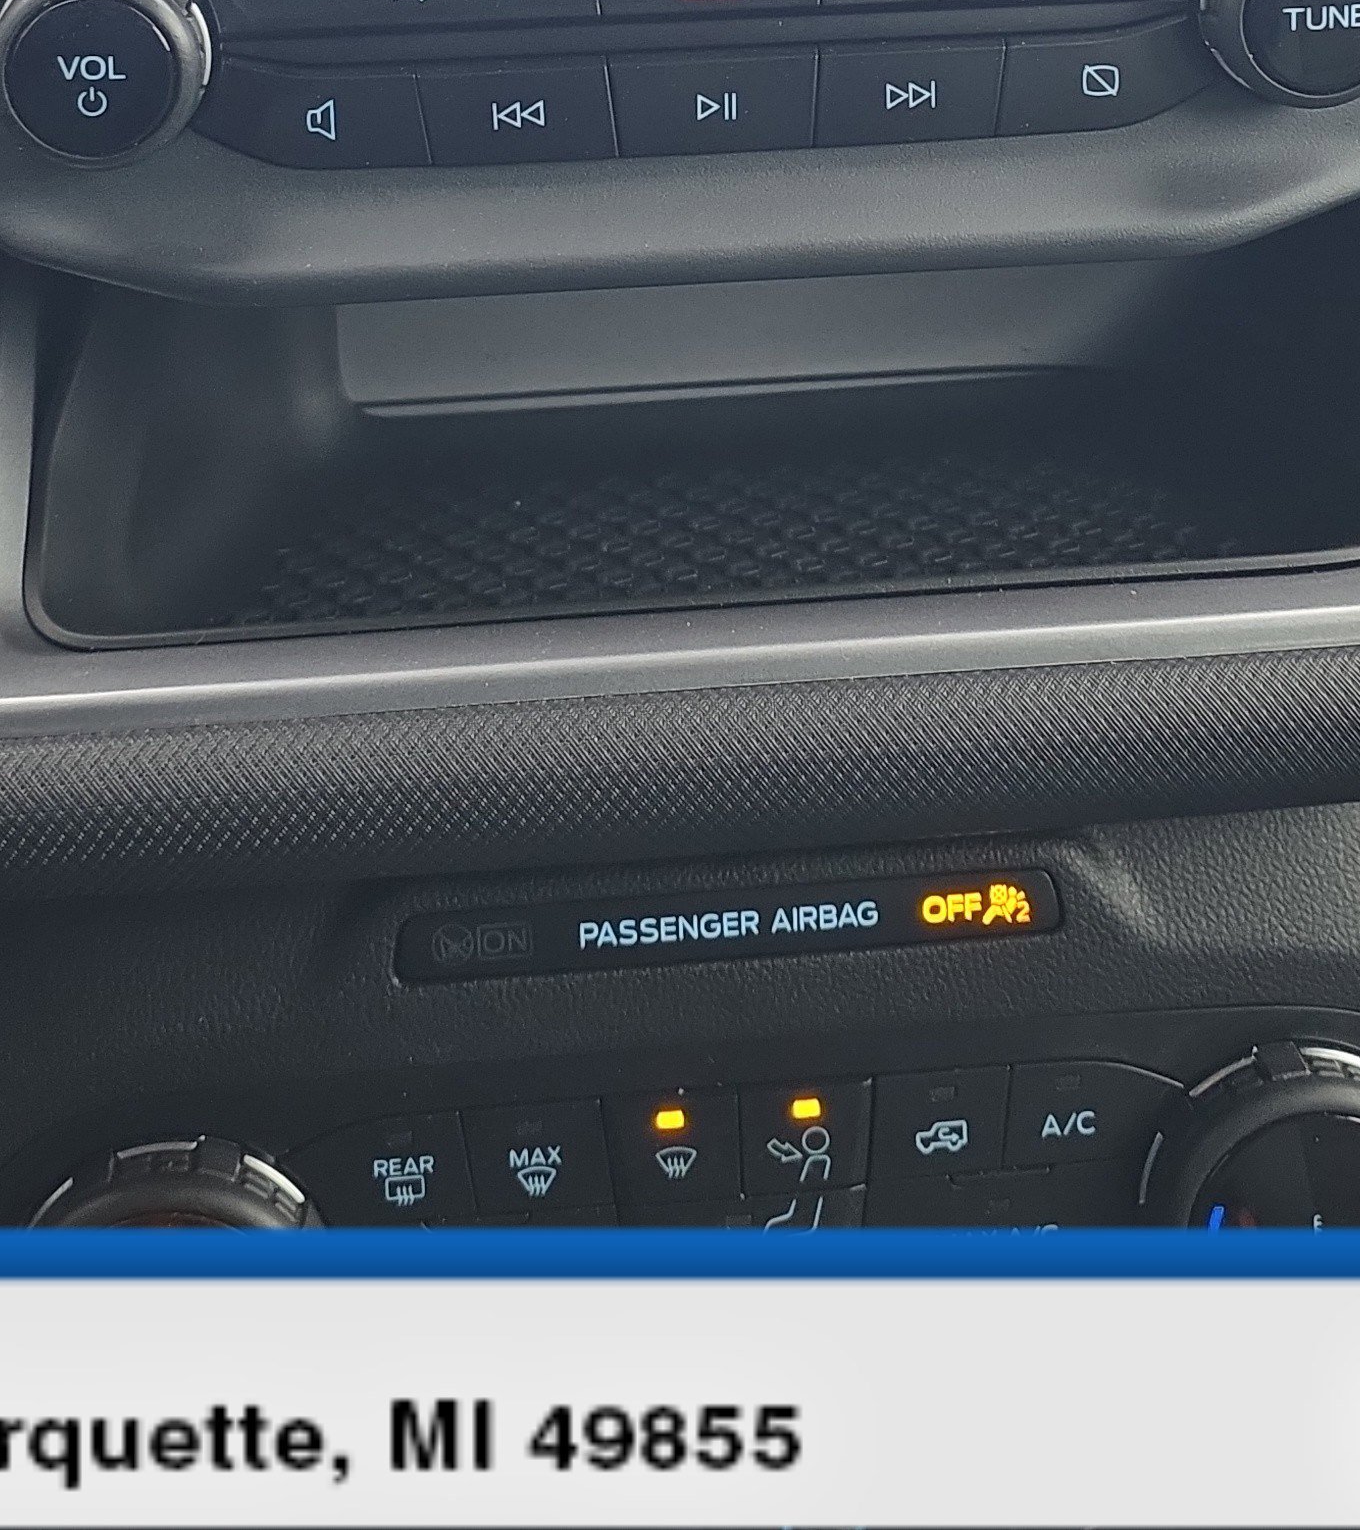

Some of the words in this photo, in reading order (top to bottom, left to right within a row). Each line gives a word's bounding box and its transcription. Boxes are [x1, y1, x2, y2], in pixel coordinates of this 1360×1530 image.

[57, 55, 127, 81] VOL
[579, 909, 761, 950] PASSENGER
[770, 900, 879, 934] AIRBAG
[921, 892, 982, 925] OFF
[1042, 1110, 1096, 1138] A/C
[373, 1155, 435, 1178] REAR
[509, 1145, 562, 1168] MAX
